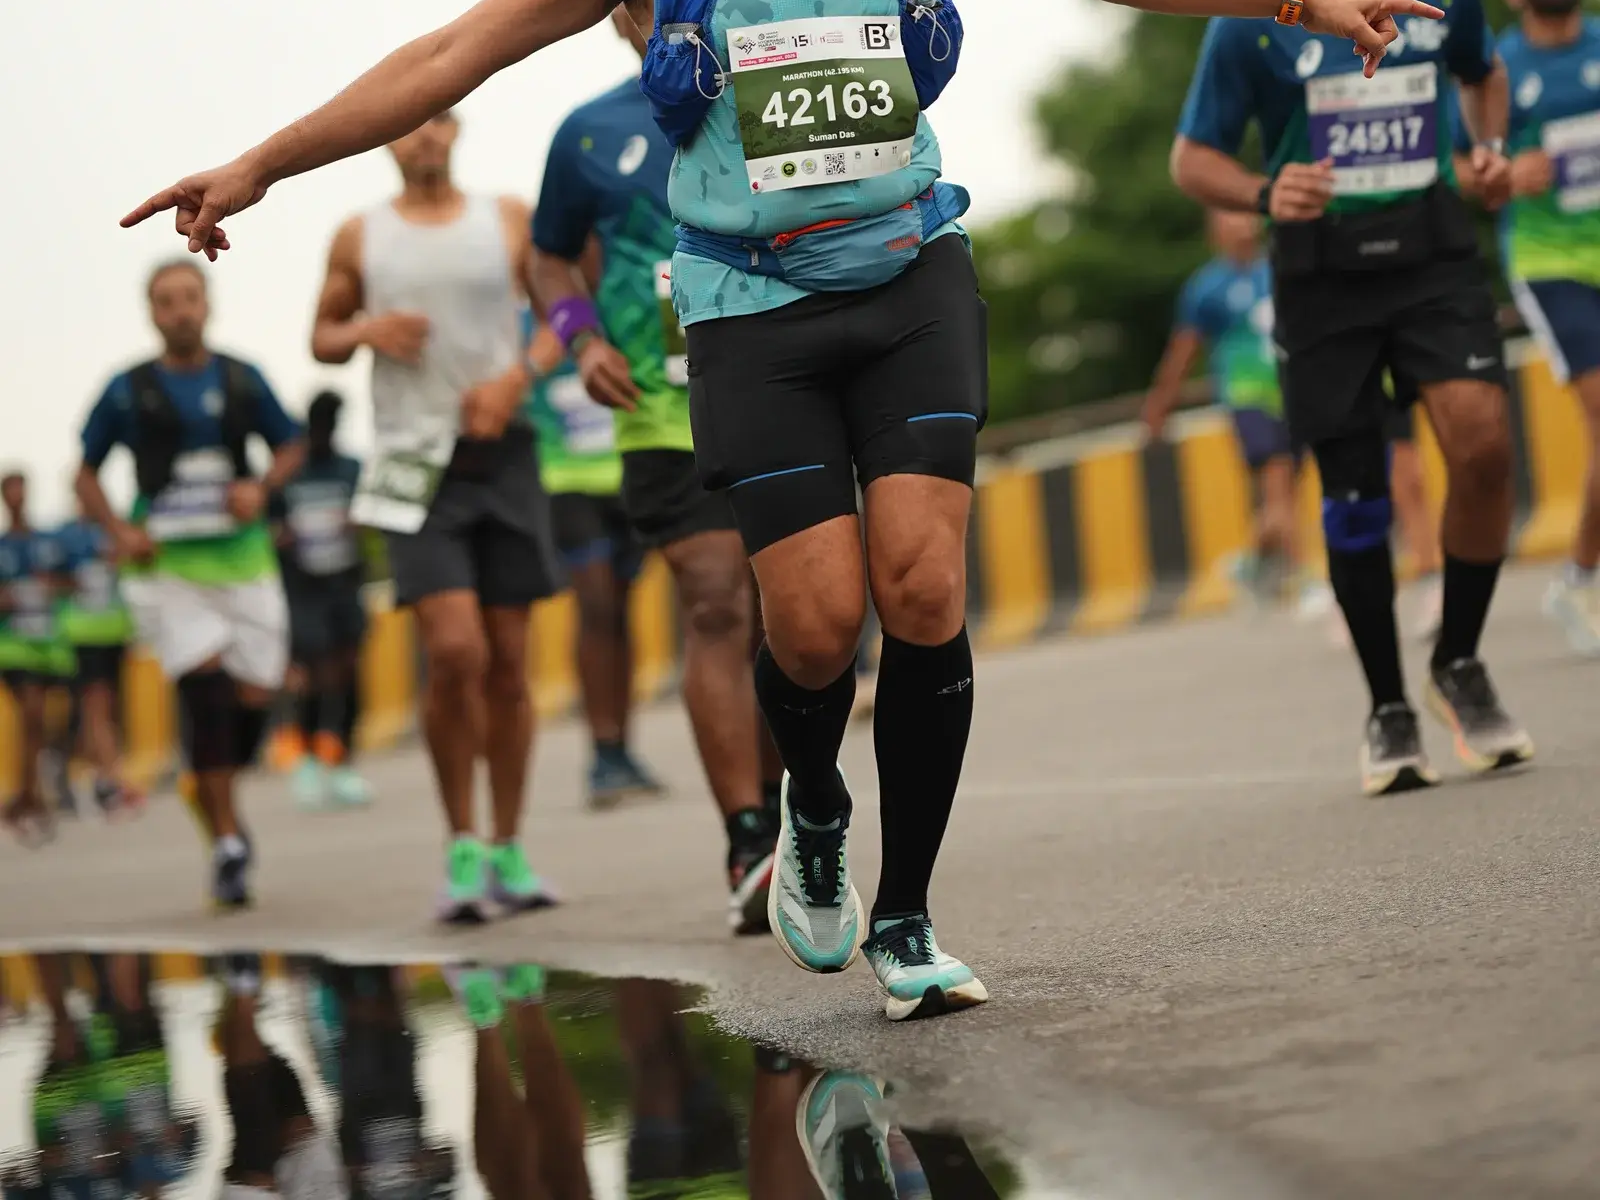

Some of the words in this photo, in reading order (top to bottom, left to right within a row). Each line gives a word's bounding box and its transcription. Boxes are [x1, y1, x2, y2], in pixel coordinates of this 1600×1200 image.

[868, 26, 886, 48] B
[782, 70, 823, 82] MARATHON
[824, 67, 850, 77] (42.195
[850, 66, 865, 74] KM)
[761, 79, 894, 128] 42163
[808, 134, 838, 142] Suman
[839, 130, 856, 139] Das
[1327, 115, 1424, 157] 24517
